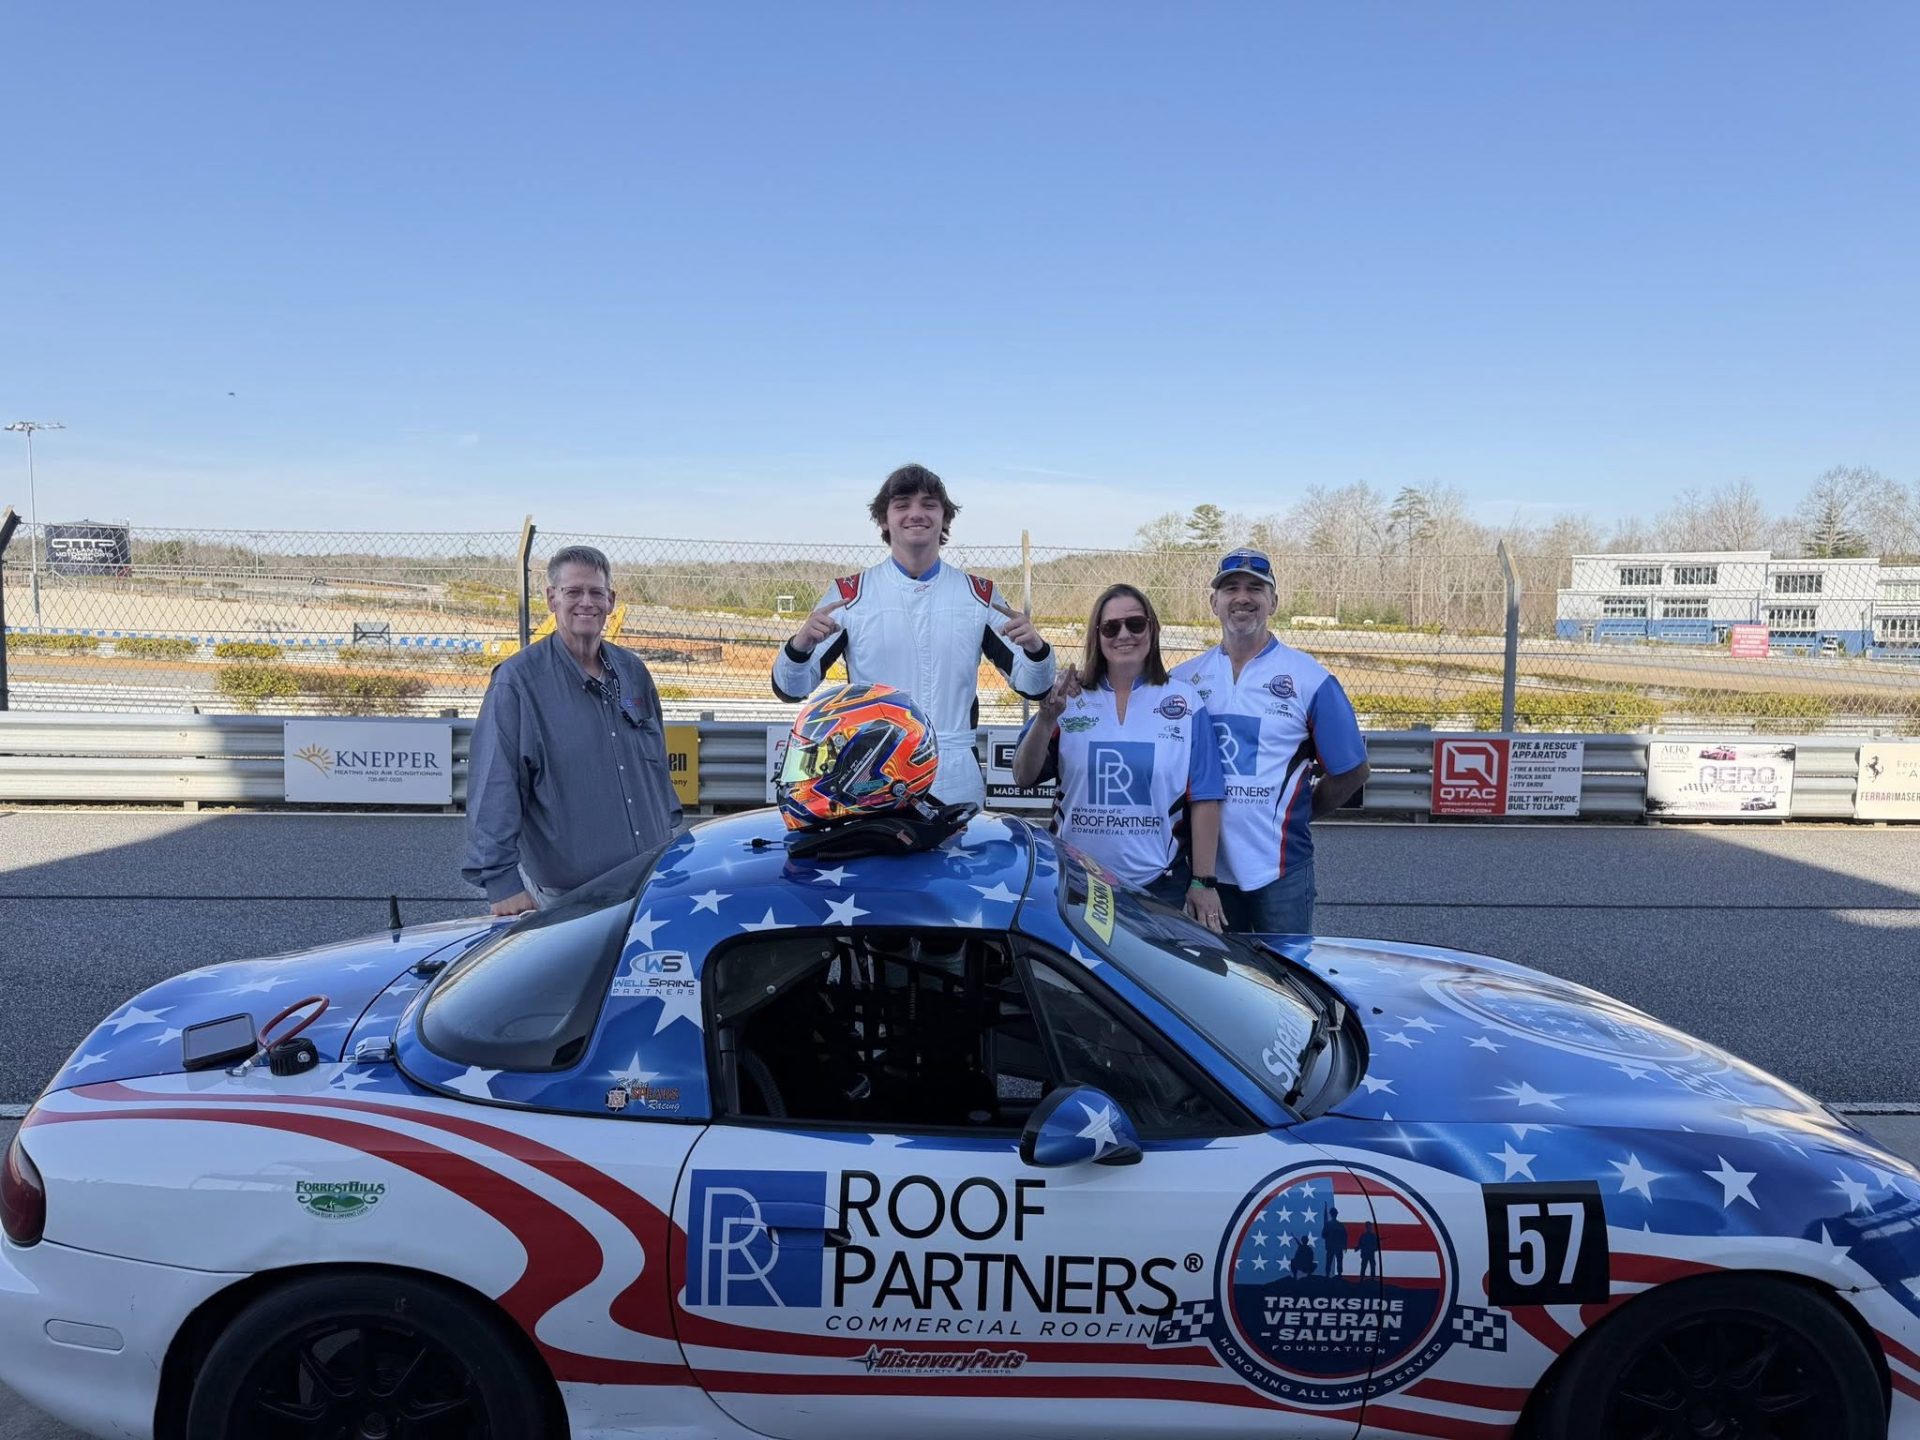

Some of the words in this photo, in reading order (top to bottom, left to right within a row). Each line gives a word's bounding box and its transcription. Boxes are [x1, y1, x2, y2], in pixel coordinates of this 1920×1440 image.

[1512, 742, 1532, 750] FIRE
[1534, 742, 1540, 750] &
[1543, 742, 1578, 750] RESCUE
[336, 750, 440, 769] KNEPPER
[1512, 751, 1567, 759] APPARATUS
[993, 787, 1020, 796] MADE
[1037, 788, 1056, 797] THE
[1226, 786, 1270, 797] RTNERS
[1439, 788, 1497, 800] QTAC
[1072, 814, 1105, 827] ROOF
[1072, 827, 1125, 836] COMMERCIAL
[647, 1099, 680, 1113] Racing
[838, 1168, 1047, 1242] ROOF
[1507, 1202, 1585, 1287] 57
[1264, 1296, 1404, 1312] TRACKSIDE
[825, 1315, 1022, 1337] COMMERCIAL
[1264, 1312, 1402, 1328] VETERAN
[1278, 1328, 1378, 1342] SALUTE
[1272, 1345, 1386, 1355] FOUNDATION
[1219, 1337, 1291, 1393] HONORING
[1297, 1391, 1330, 1399] ALL
[1337, 1385, 1376, 1398] WHO
[1383, 1341, 1442, 1387] SERVED
